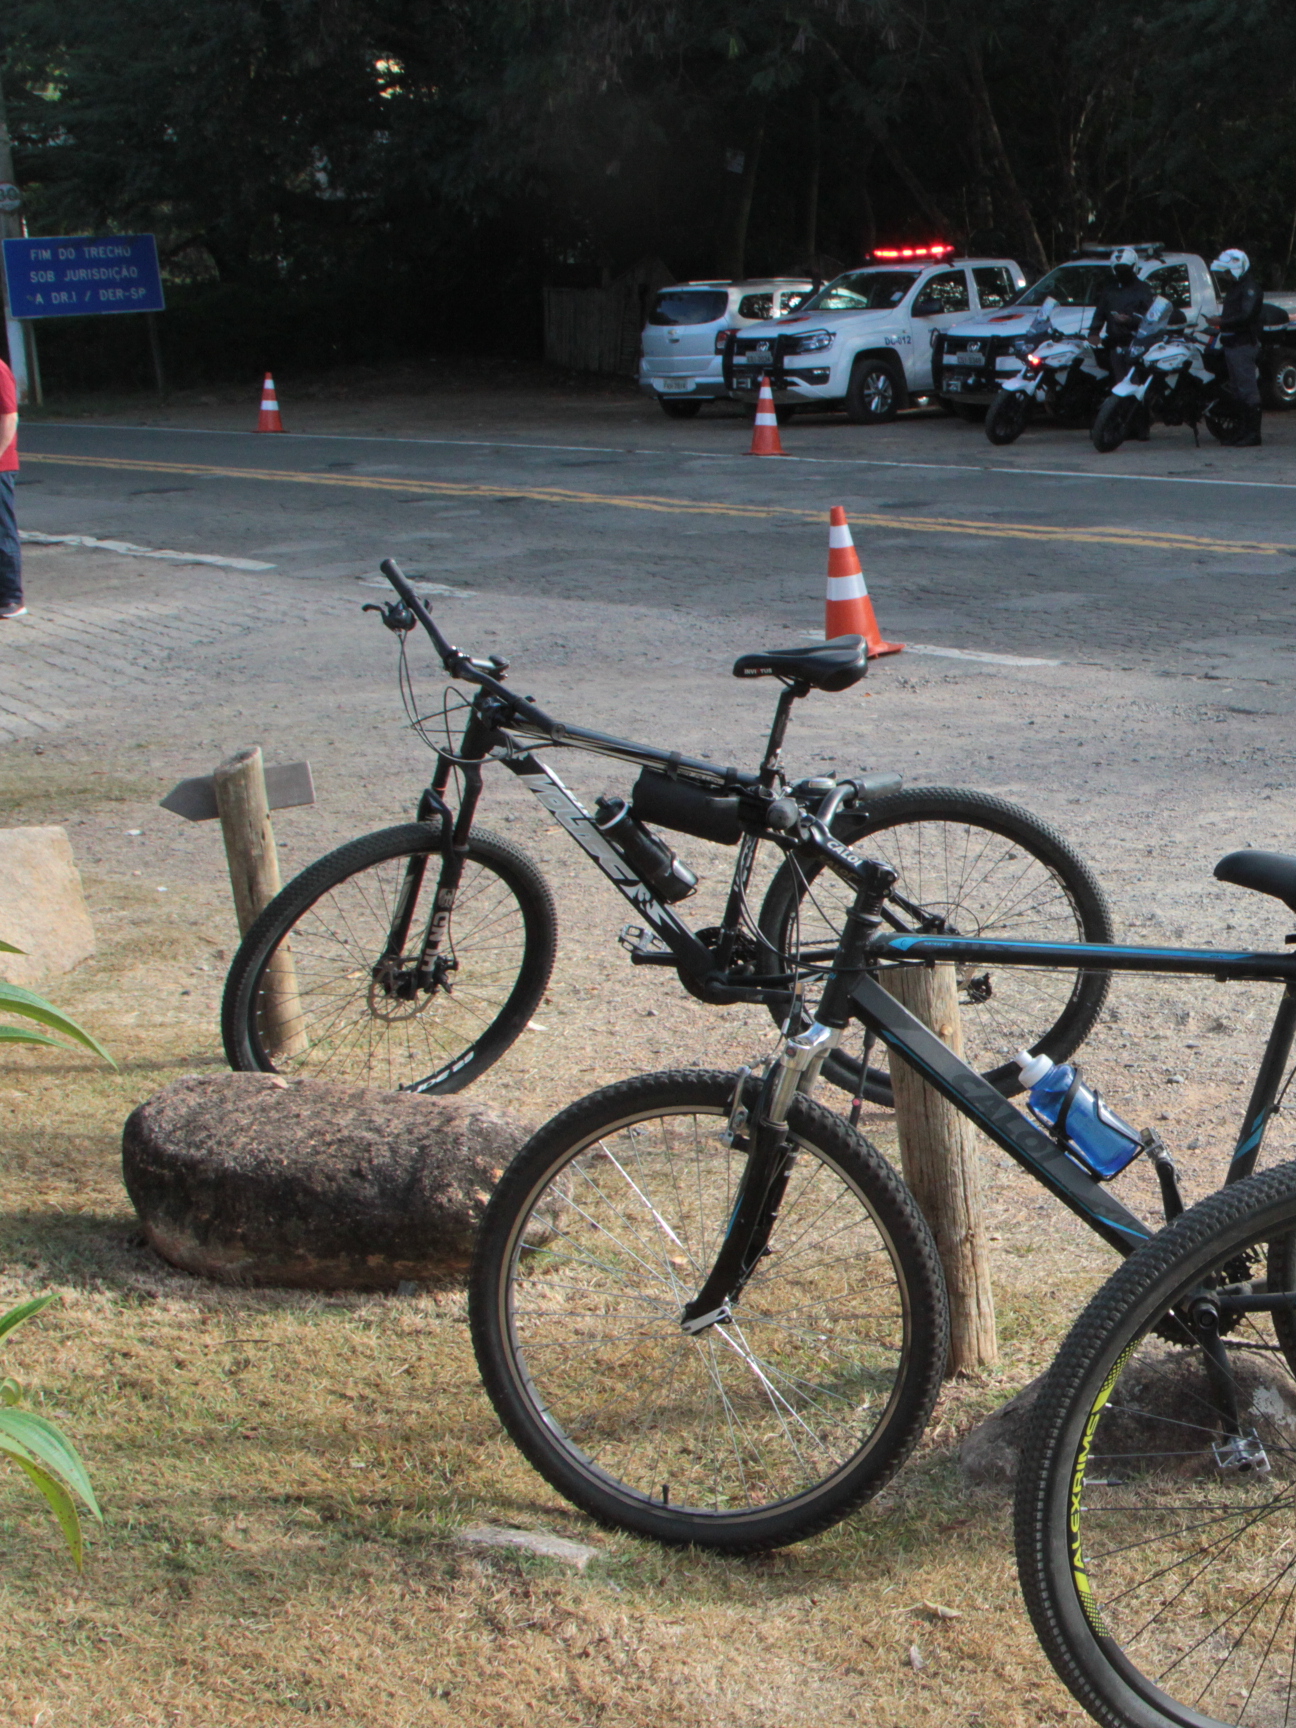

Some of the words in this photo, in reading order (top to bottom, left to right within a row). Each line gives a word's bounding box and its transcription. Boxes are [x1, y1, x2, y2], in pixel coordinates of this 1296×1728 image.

[30, 249, 51, 260] FIM
[58, 248, 76, 260] DO
[83, 246, 131, 259] TRECHO
[30, 270, 56, 282] SOB
[64, 265, 138, 282] JURISDIÇÃO
[99, 287, 146, 301] DER-SP
[827, 840, 864, 868] CALOI
[951, 1072, 1067, 1164] CALOI
[1070, 1412, 1101, 1569] ALEXRIMS
